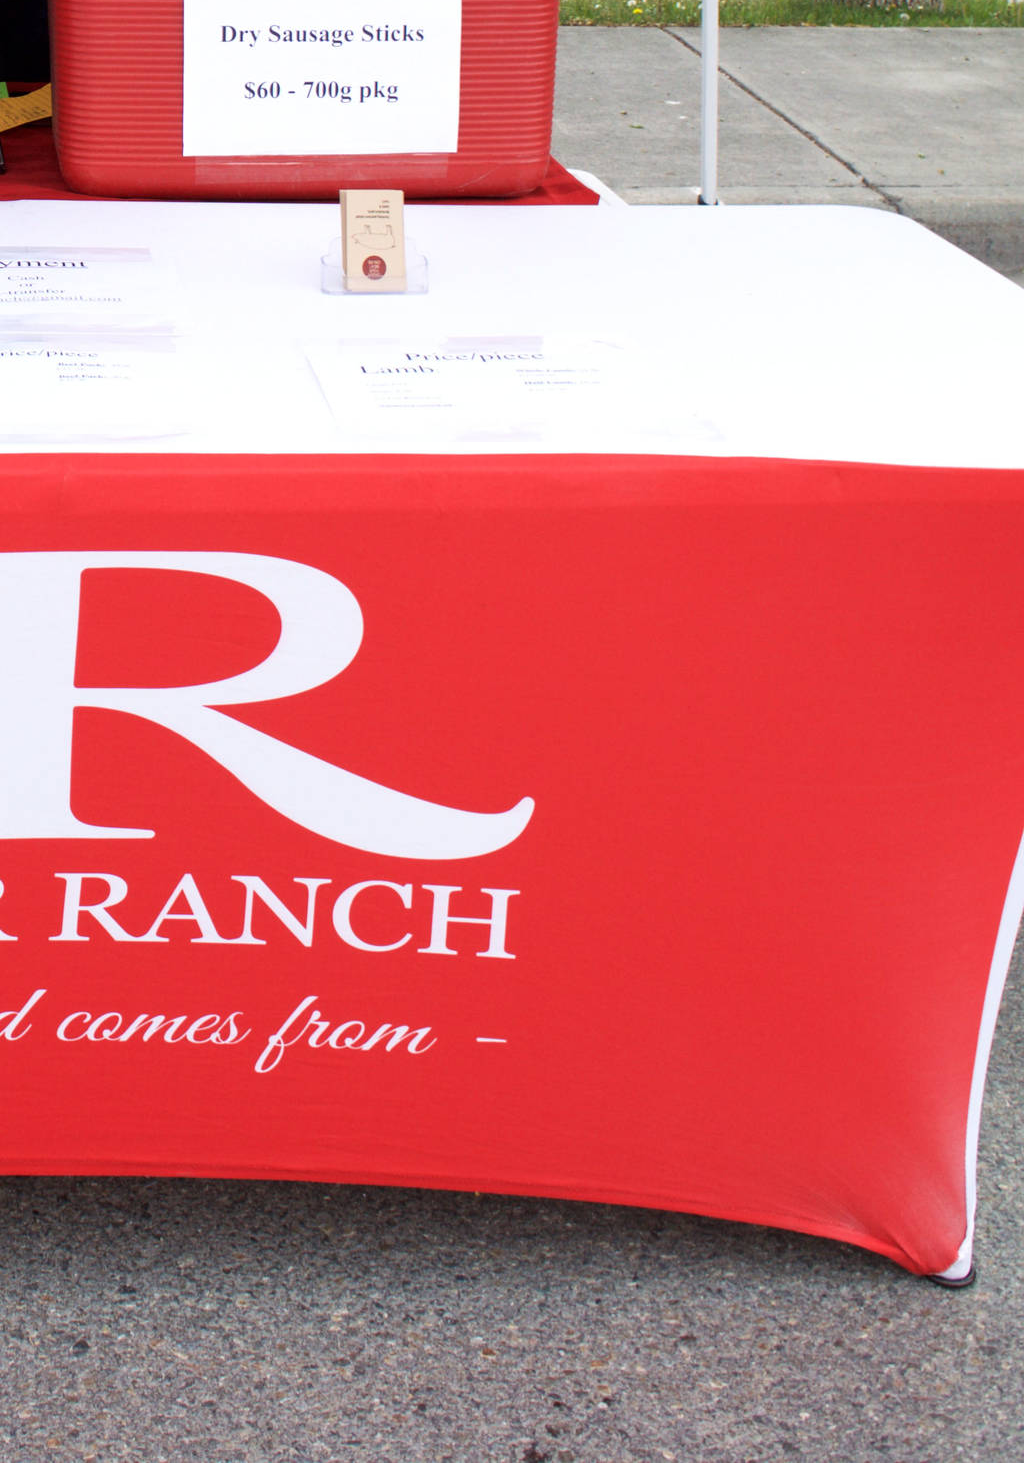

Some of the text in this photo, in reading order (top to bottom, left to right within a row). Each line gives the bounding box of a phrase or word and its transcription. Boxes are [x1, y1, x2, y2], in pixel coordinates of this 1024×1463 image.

[221, 24, 425, 47] Dry Sausage Sticks
[244, 81, 281, 100] $60
[303, 80, 353, 103] 700g
[359, 80, 400, 103] pkg
[404, 351, 545, 363] Price/piece
[47, 872, 521, 960] RANCH
[56, 1009, 252, 1044] comes
[254, 995, 438, 1074] from
